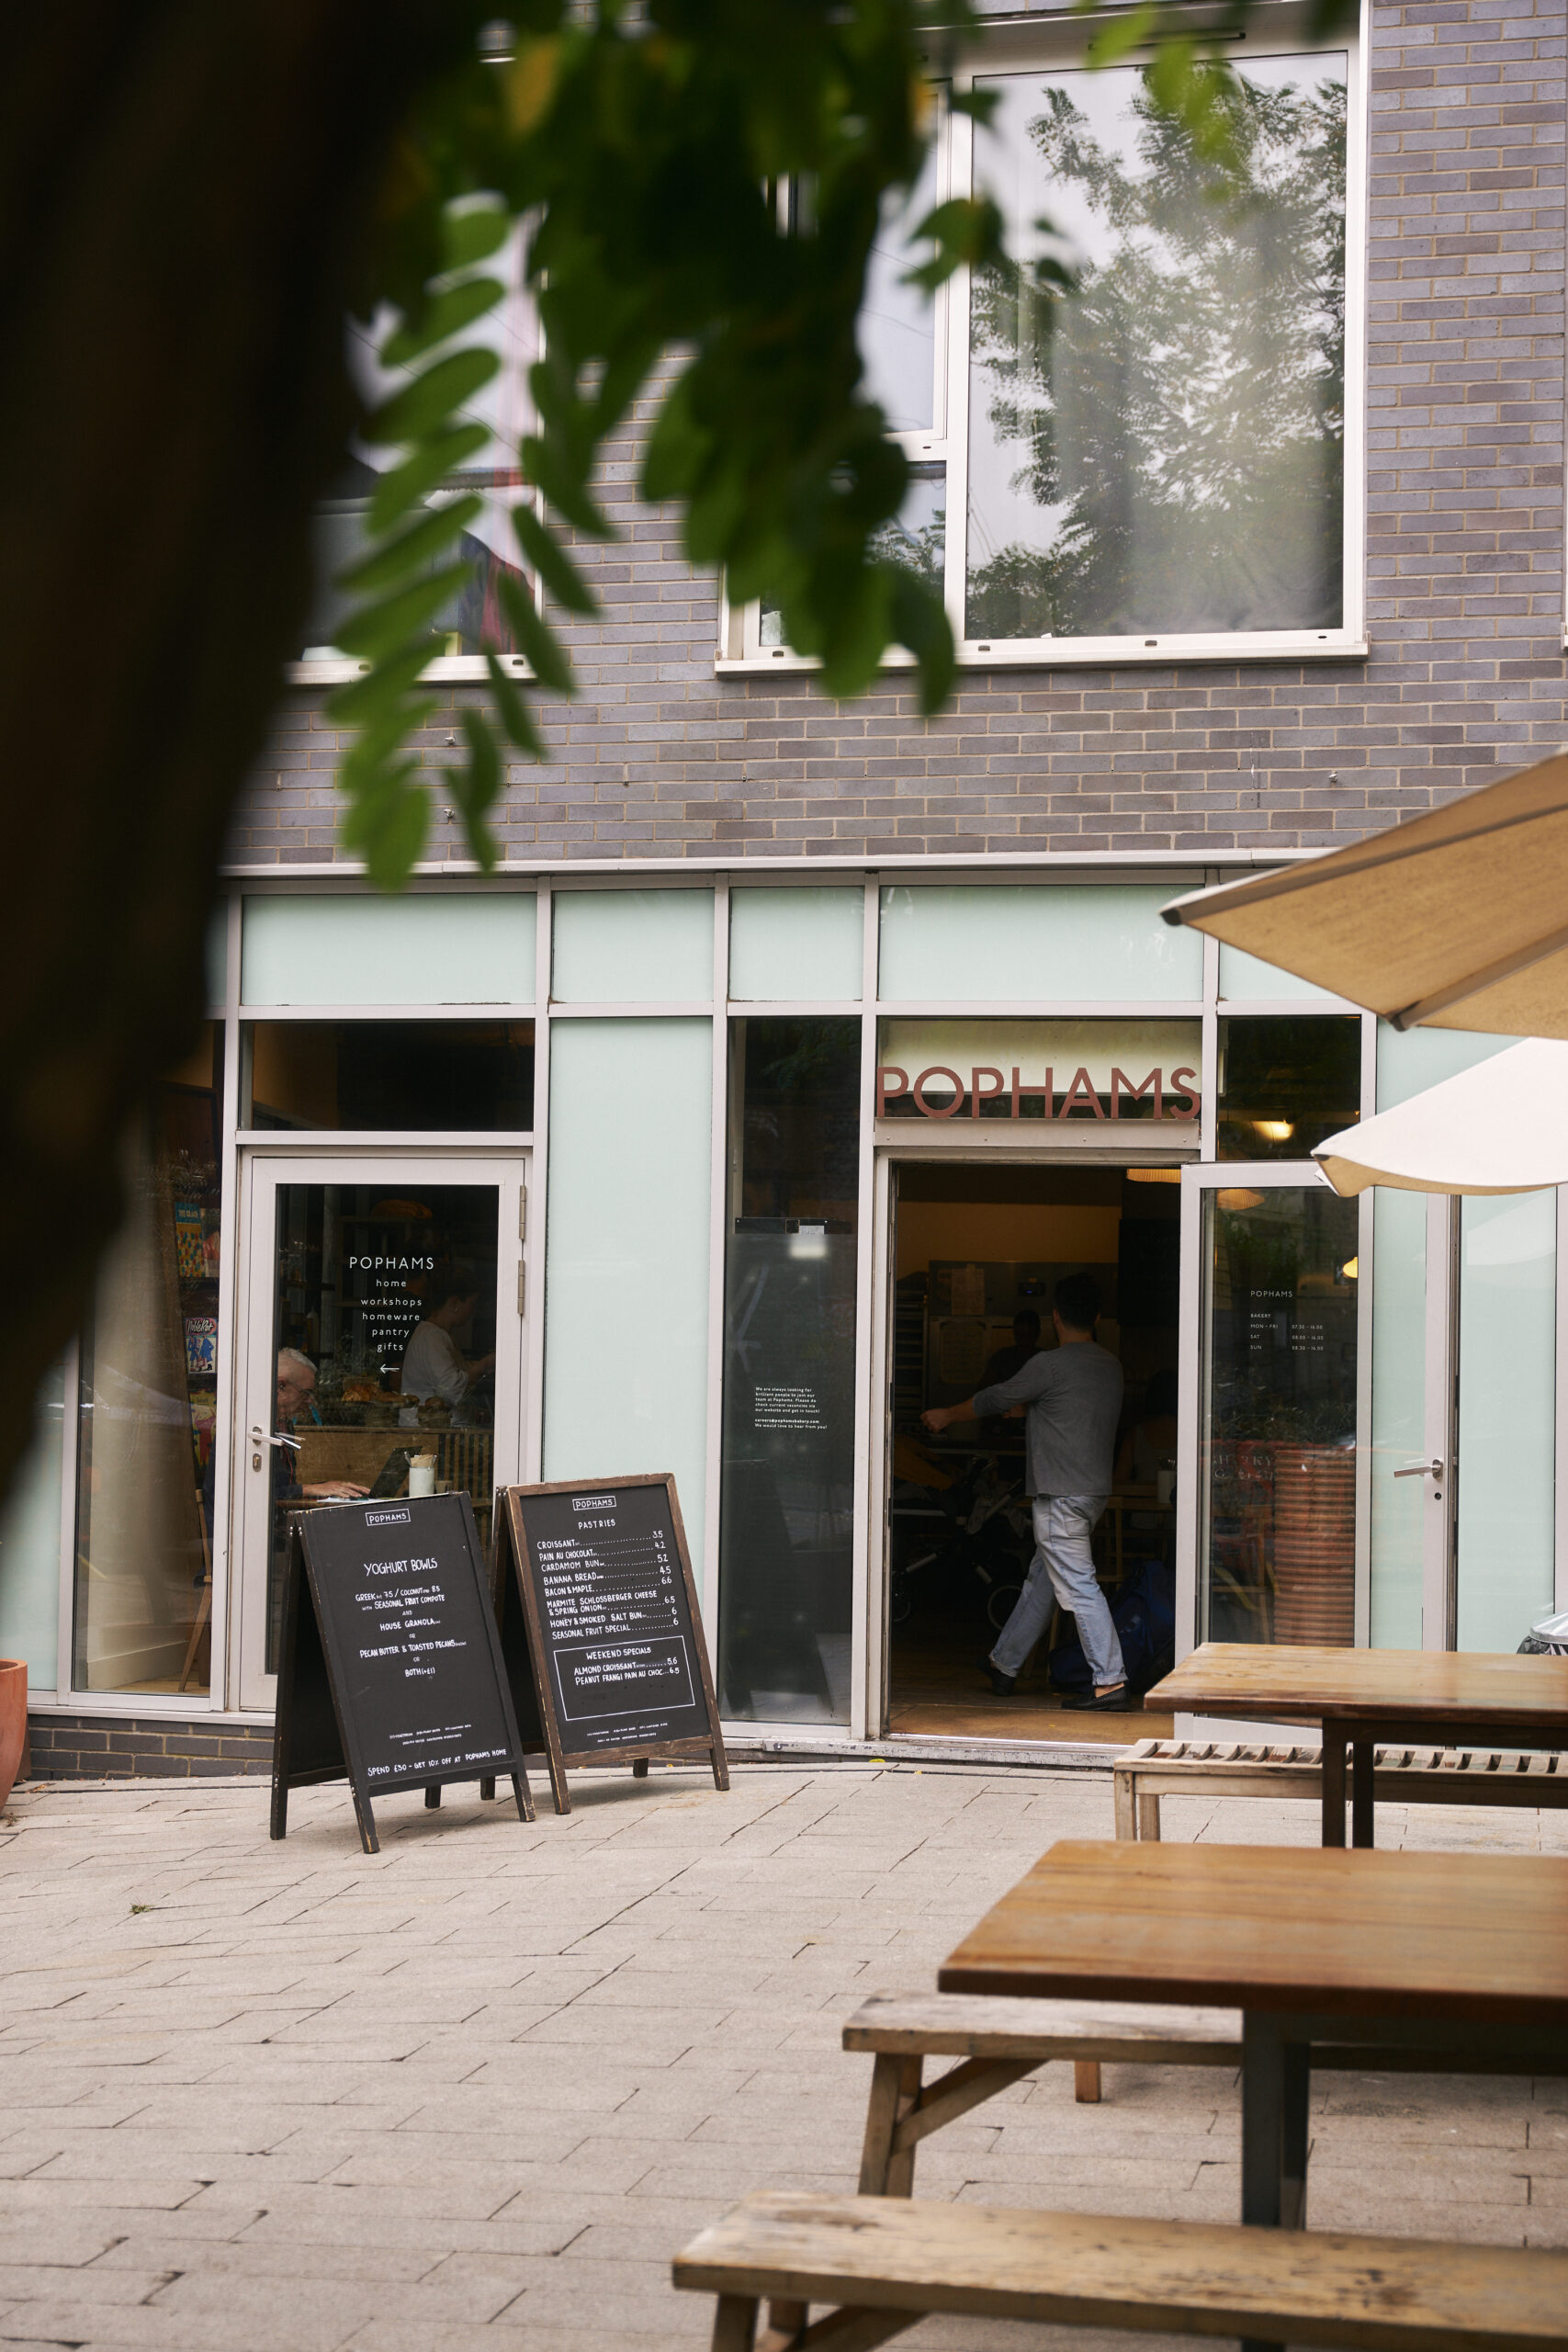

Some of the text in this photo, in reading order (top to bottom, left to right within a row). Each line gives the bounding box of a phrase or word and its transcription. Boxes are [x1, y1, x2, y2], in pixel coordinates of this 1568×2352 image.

[876, 1067, 1201, 1120] POPHAMS
[349, 1257, 434, 1269] POPHAMS
[361, 1297, 422, 1307] workshops
[372, 1329, 409, 1338] pantry
[378, 1342, 403, 1352] gifts
[576, 1499, 613, 1508] POPHAMS
[369, 1513, 407, 1523] POPHAMS
[579, 1519, 615, 1530] PASTRIES
[537, 1539, 575, 1549] CROISSANT
[539, 1553, 554, 1562] PAIN
[557, 1551, 563, 1559] AU
[566, 1549, 592, 1559] CHOCOLAT
[364, 1558, 437, 1577] YOGHURT BOWLS
[541, 1562, 581, 1572] CARDAMOM
[544, 1575, 572, 1585] BANANA
[575, 1572, 596, 1580] BREAD
[545, 1589, 566, 1597] BACON
[547, 1590, 657, 1608] MARMITE SCHLOSSBERGER CHEESE
[375, 1600, 403, 1609] SEASONAL
[404, 1597, 419, 1606] FRUIT
[421, 1595, 445, 1603] COMPOTE
[555, 1606, 578, 1615] SPRING
[581, 1604, 602, 1612] ONION
[380, 1622, 401, 1631] HOUSE
[550, 1619, 571, 1628] HONEY
[580, 1615, 605, 1624] SMOKED
[552, 1631, 583, 1640] SEASONAL
[586, 1626, 603, 1635] FRUIT
[605, 1624, 631, 1633] SPECIAL
[360, 1648, 378, 1658] PECAN
[378, 1646, 399, 1656] BUTTER
[408, 1642, 434, 1652] TOASTED
[586, 1647, 651, 1660] WEEKEND SPECIALS
[574, 1666, 601, 1676] ALMOND
[576, 1676, 600, 1686] PEANUT
[625, 1671, 637, 1679] PAIN
[367, 1766, 389, 1776] SPEND
[394, 1764, 407, 1772] £30
[466, 1751, 490, 1760] POPHAMS
